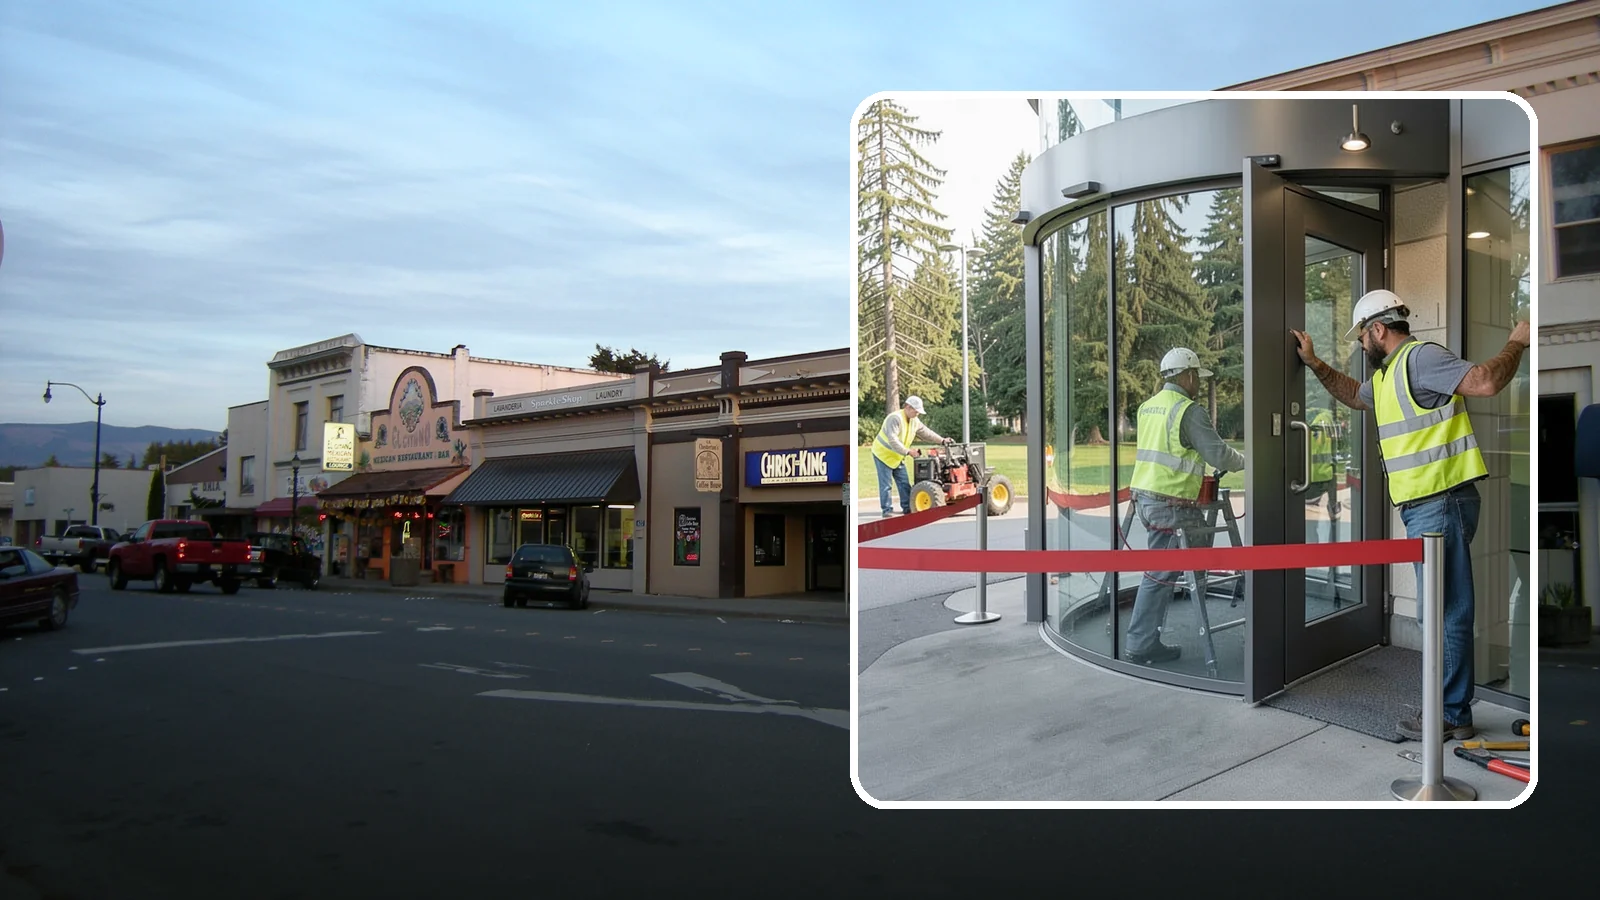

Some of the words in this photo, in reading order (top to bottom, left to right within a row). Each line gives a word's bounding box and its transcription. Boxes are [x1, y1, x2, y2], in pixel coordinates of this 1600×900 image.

[493, 402, 523, 413] LAVANDERIA
[530, 397, 561, 409] Sparkle
[561, 393, 582, 404] Shop
[595, 388, 624, 400] LAUNDRY
[373, 454, 396, 464] MEXICAN
[397, 451, 434, 462] RESTAURANT
[438, 450, 450, 459] BAR
[761, 452, 797, 478] CHRIST
[799, 450, 827, 476] KING
